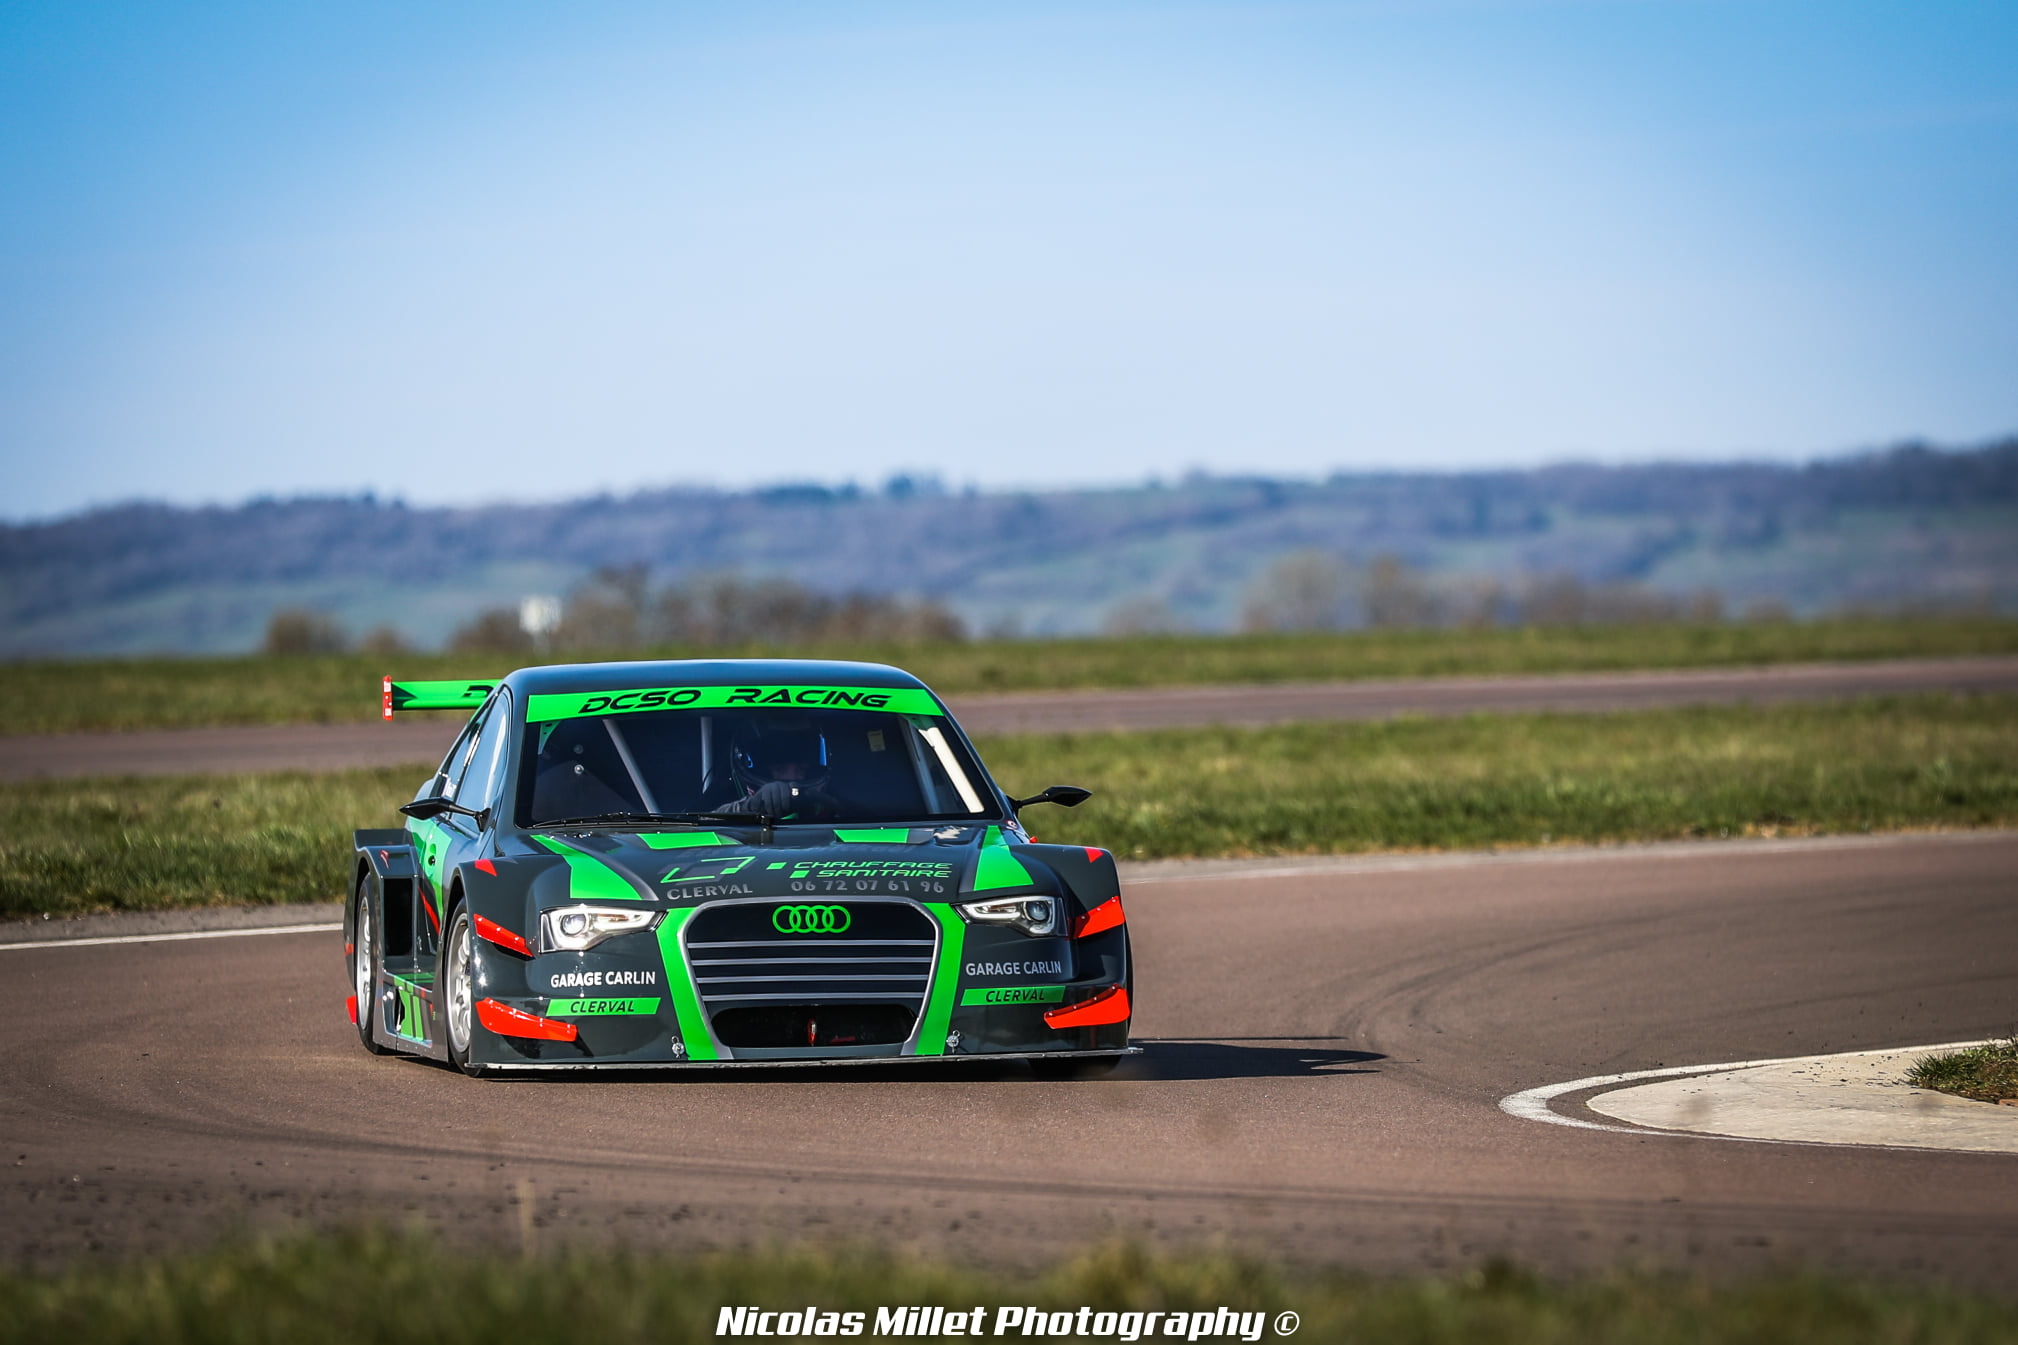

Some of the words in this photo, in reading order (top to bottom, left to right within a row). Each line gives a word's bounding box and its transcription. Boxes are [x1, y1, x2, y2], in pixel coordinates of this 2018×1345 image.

[578, 689, 702, 714] DCSO
[726, 688, 892, 708] RACING
[794, 861, 953, 869] CHAUFFAGE
[816, 869, 952, 878] SANITAIRE
[666, 883, 753, 900] CLERVAL
[791, 881, 816, 892] 06
[824, 880, 848, 891] 72
[856, 879, 878, 891] 07
[920, 881, 944, 893] 96
[965, 962, 1021, 976] GARAGE
[1023, 960, 1062, 974] CARLIN
[550, 972, 602, 988] GARAGE
[605, 971, 656, 985] CARLIN
[984, 989, 1045, 1002] CLERVAL
[570, 1000, 635, 1013] CLERVAL
